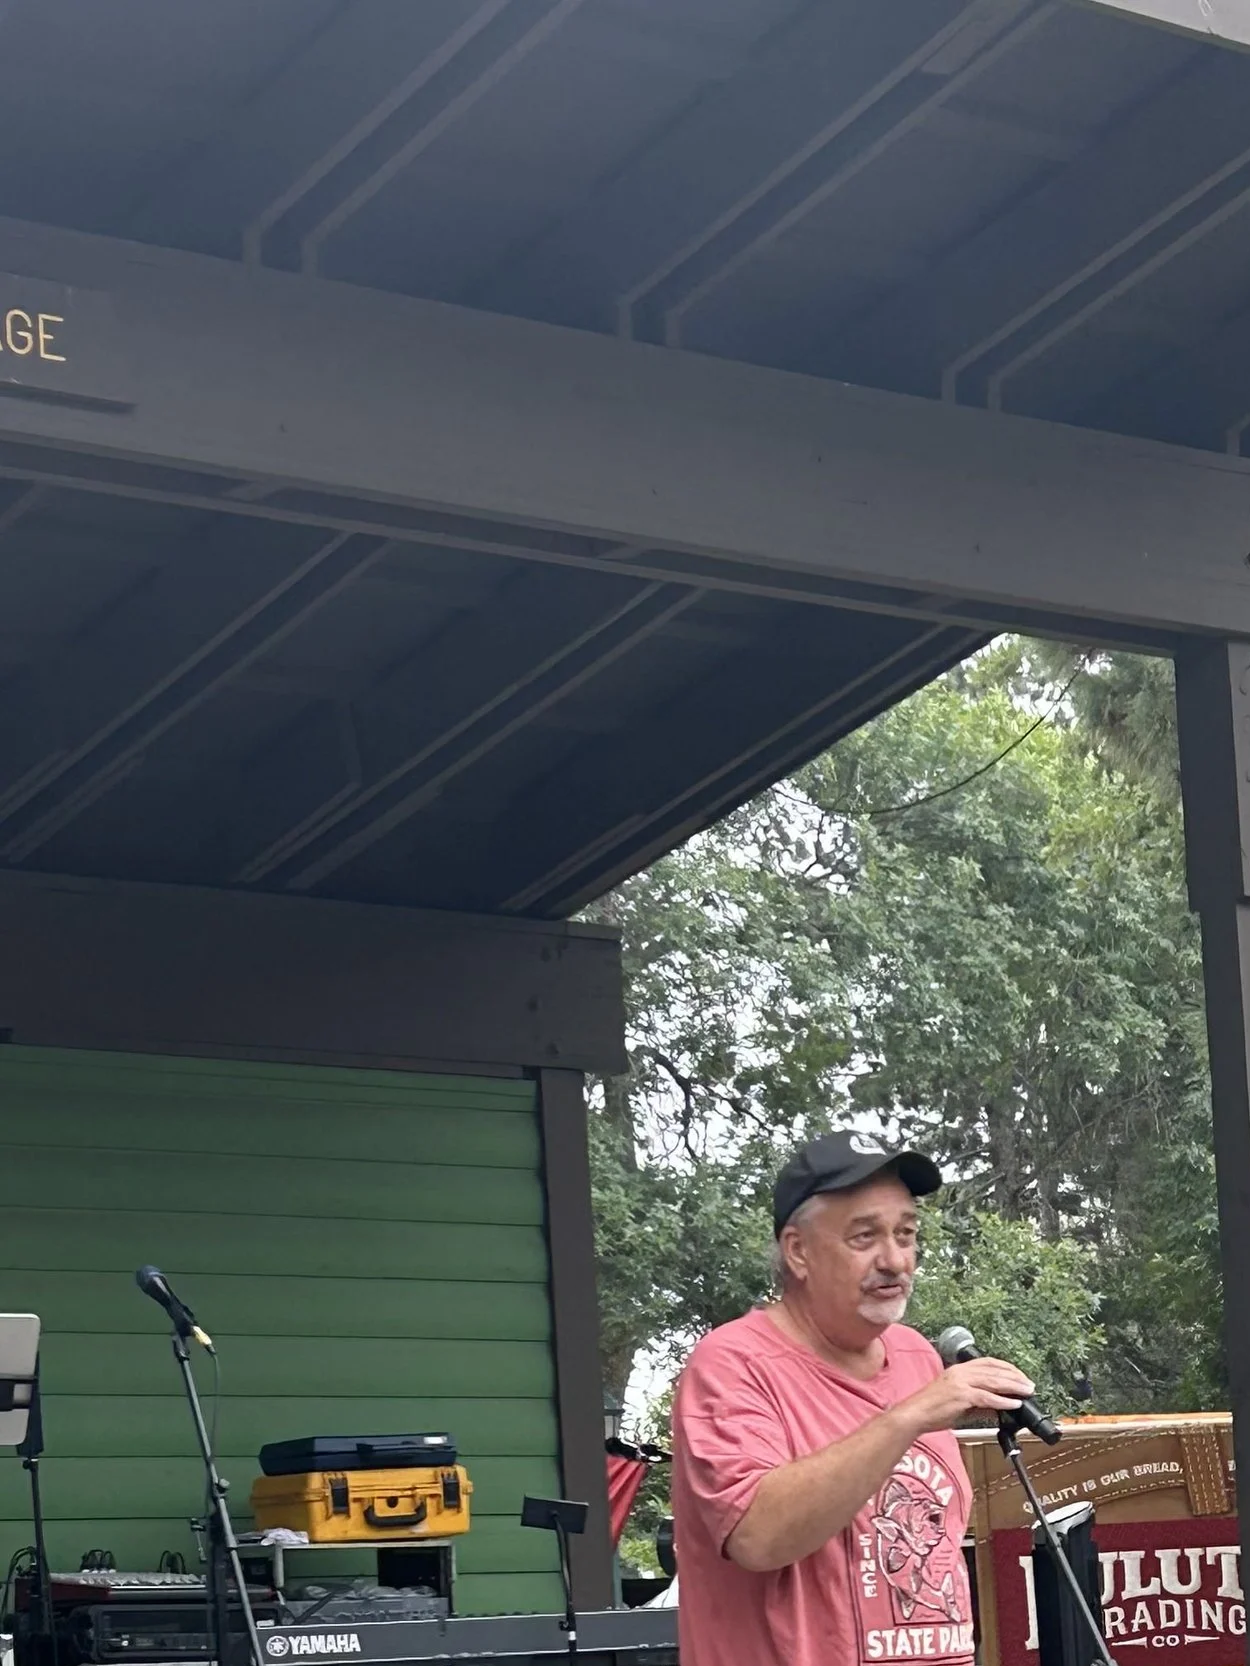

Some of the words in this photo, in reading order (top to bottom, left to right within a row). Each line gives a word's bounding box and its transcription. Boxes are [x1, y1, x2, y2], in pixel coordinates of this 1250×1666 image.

[0, 309, 67, 362] GE
[893, 1450, 954, 1506] SOTA
[1022, 1485, 1078, 1514] QALITY
[1082, 1478, 1097, 1493] IS
[858, 1533, 879, 1598] SINCE
[1103, 1599, 1247, 1638] RADING
[289, 1633, 362, 1655] YAMAHA
[867, 1628, 935, 1658] STATE
[938, 1624, 975, 1654] PAR
[1151, 1635, 1180, 1647] CO
